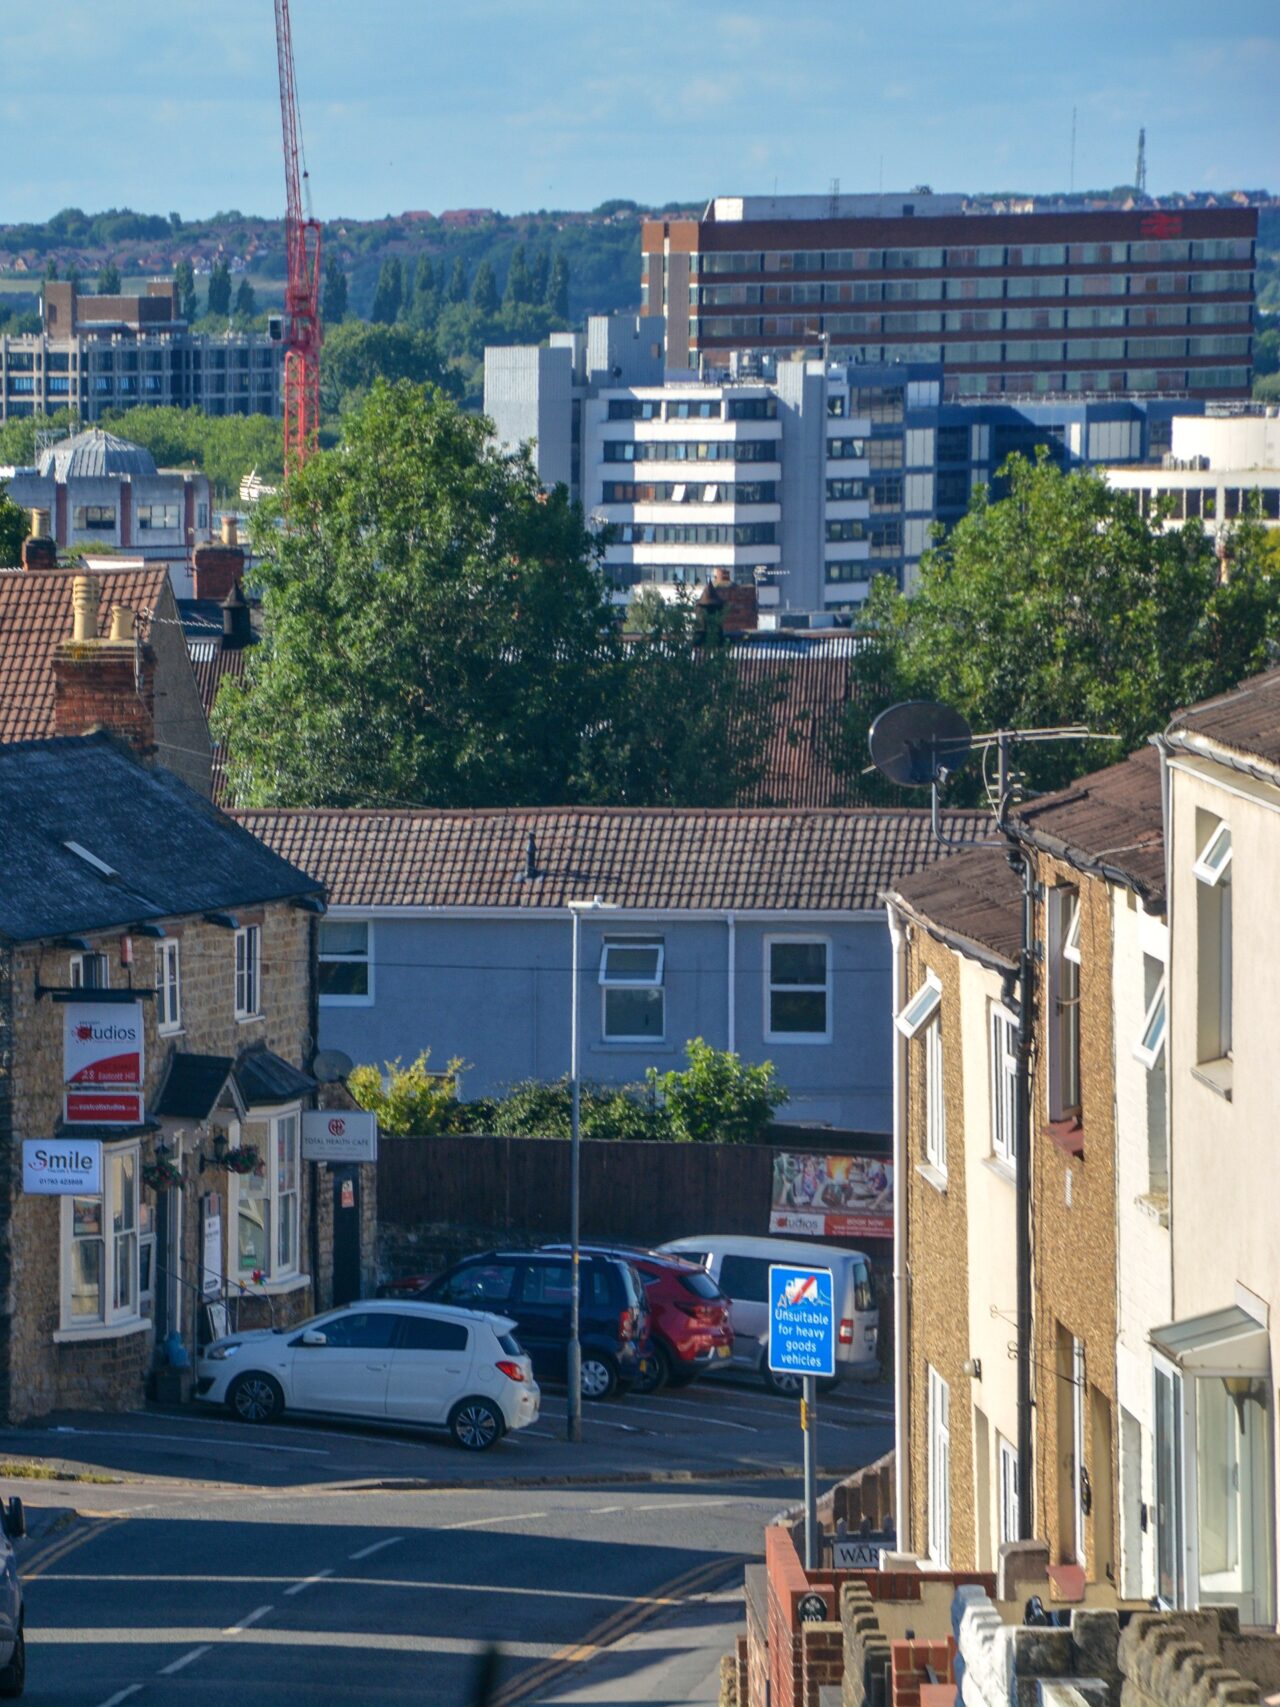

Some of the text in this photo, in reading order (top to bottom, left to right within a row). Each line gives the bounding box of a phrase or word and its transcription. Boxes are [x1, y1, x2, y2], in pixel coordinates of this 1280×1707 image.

[304, 1137, 324, 1145] TOTAL
[325, 1137, 351, 1145] HEALTH
[31, 1150, 93, 1170] Smile
[775, 1309, 829, 1325] Unsuitable
[778, 1323, 825, 1341] for heavy
[786, 1340, 817, 1353] goods
[781, 1353, 822, 1367] vehicles
[839, 1547, 888, 1563] WAR
